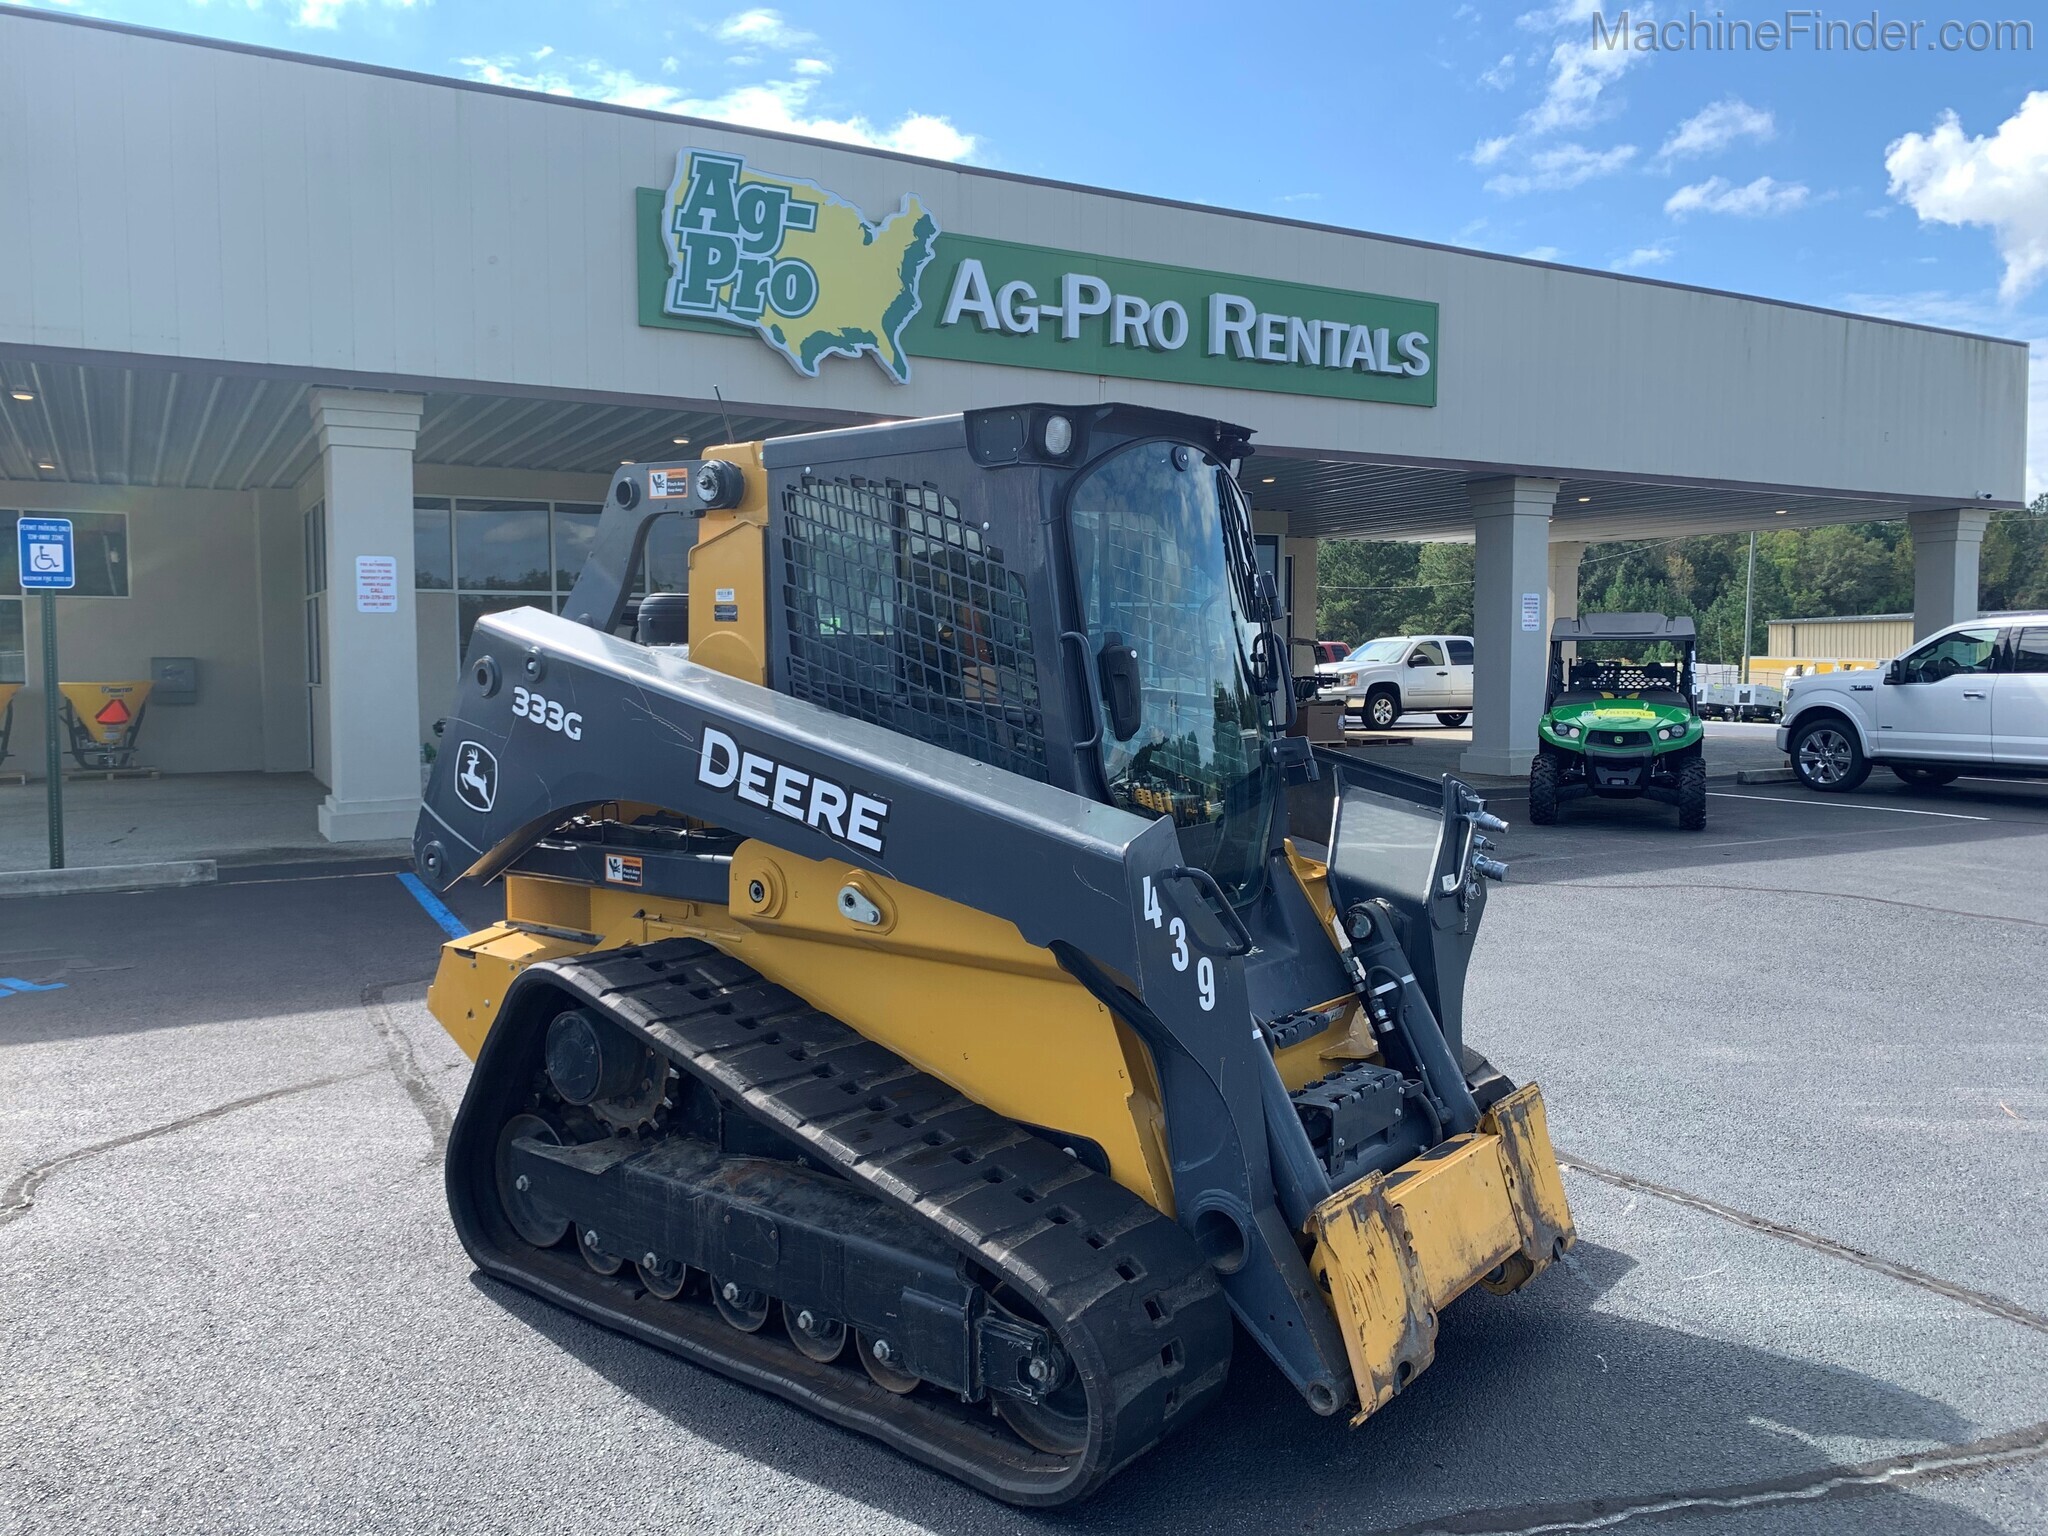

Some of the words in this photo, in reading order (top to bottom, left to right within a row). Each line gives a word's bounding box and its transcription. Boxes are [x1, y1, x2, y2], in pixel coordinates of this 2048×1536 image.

[672, 152, 819, 257] Ag-
[672, 230, 819, 319] Pro
[511, 686, 583, 741] 333G
[698, 727, 888, 852] DEERE
